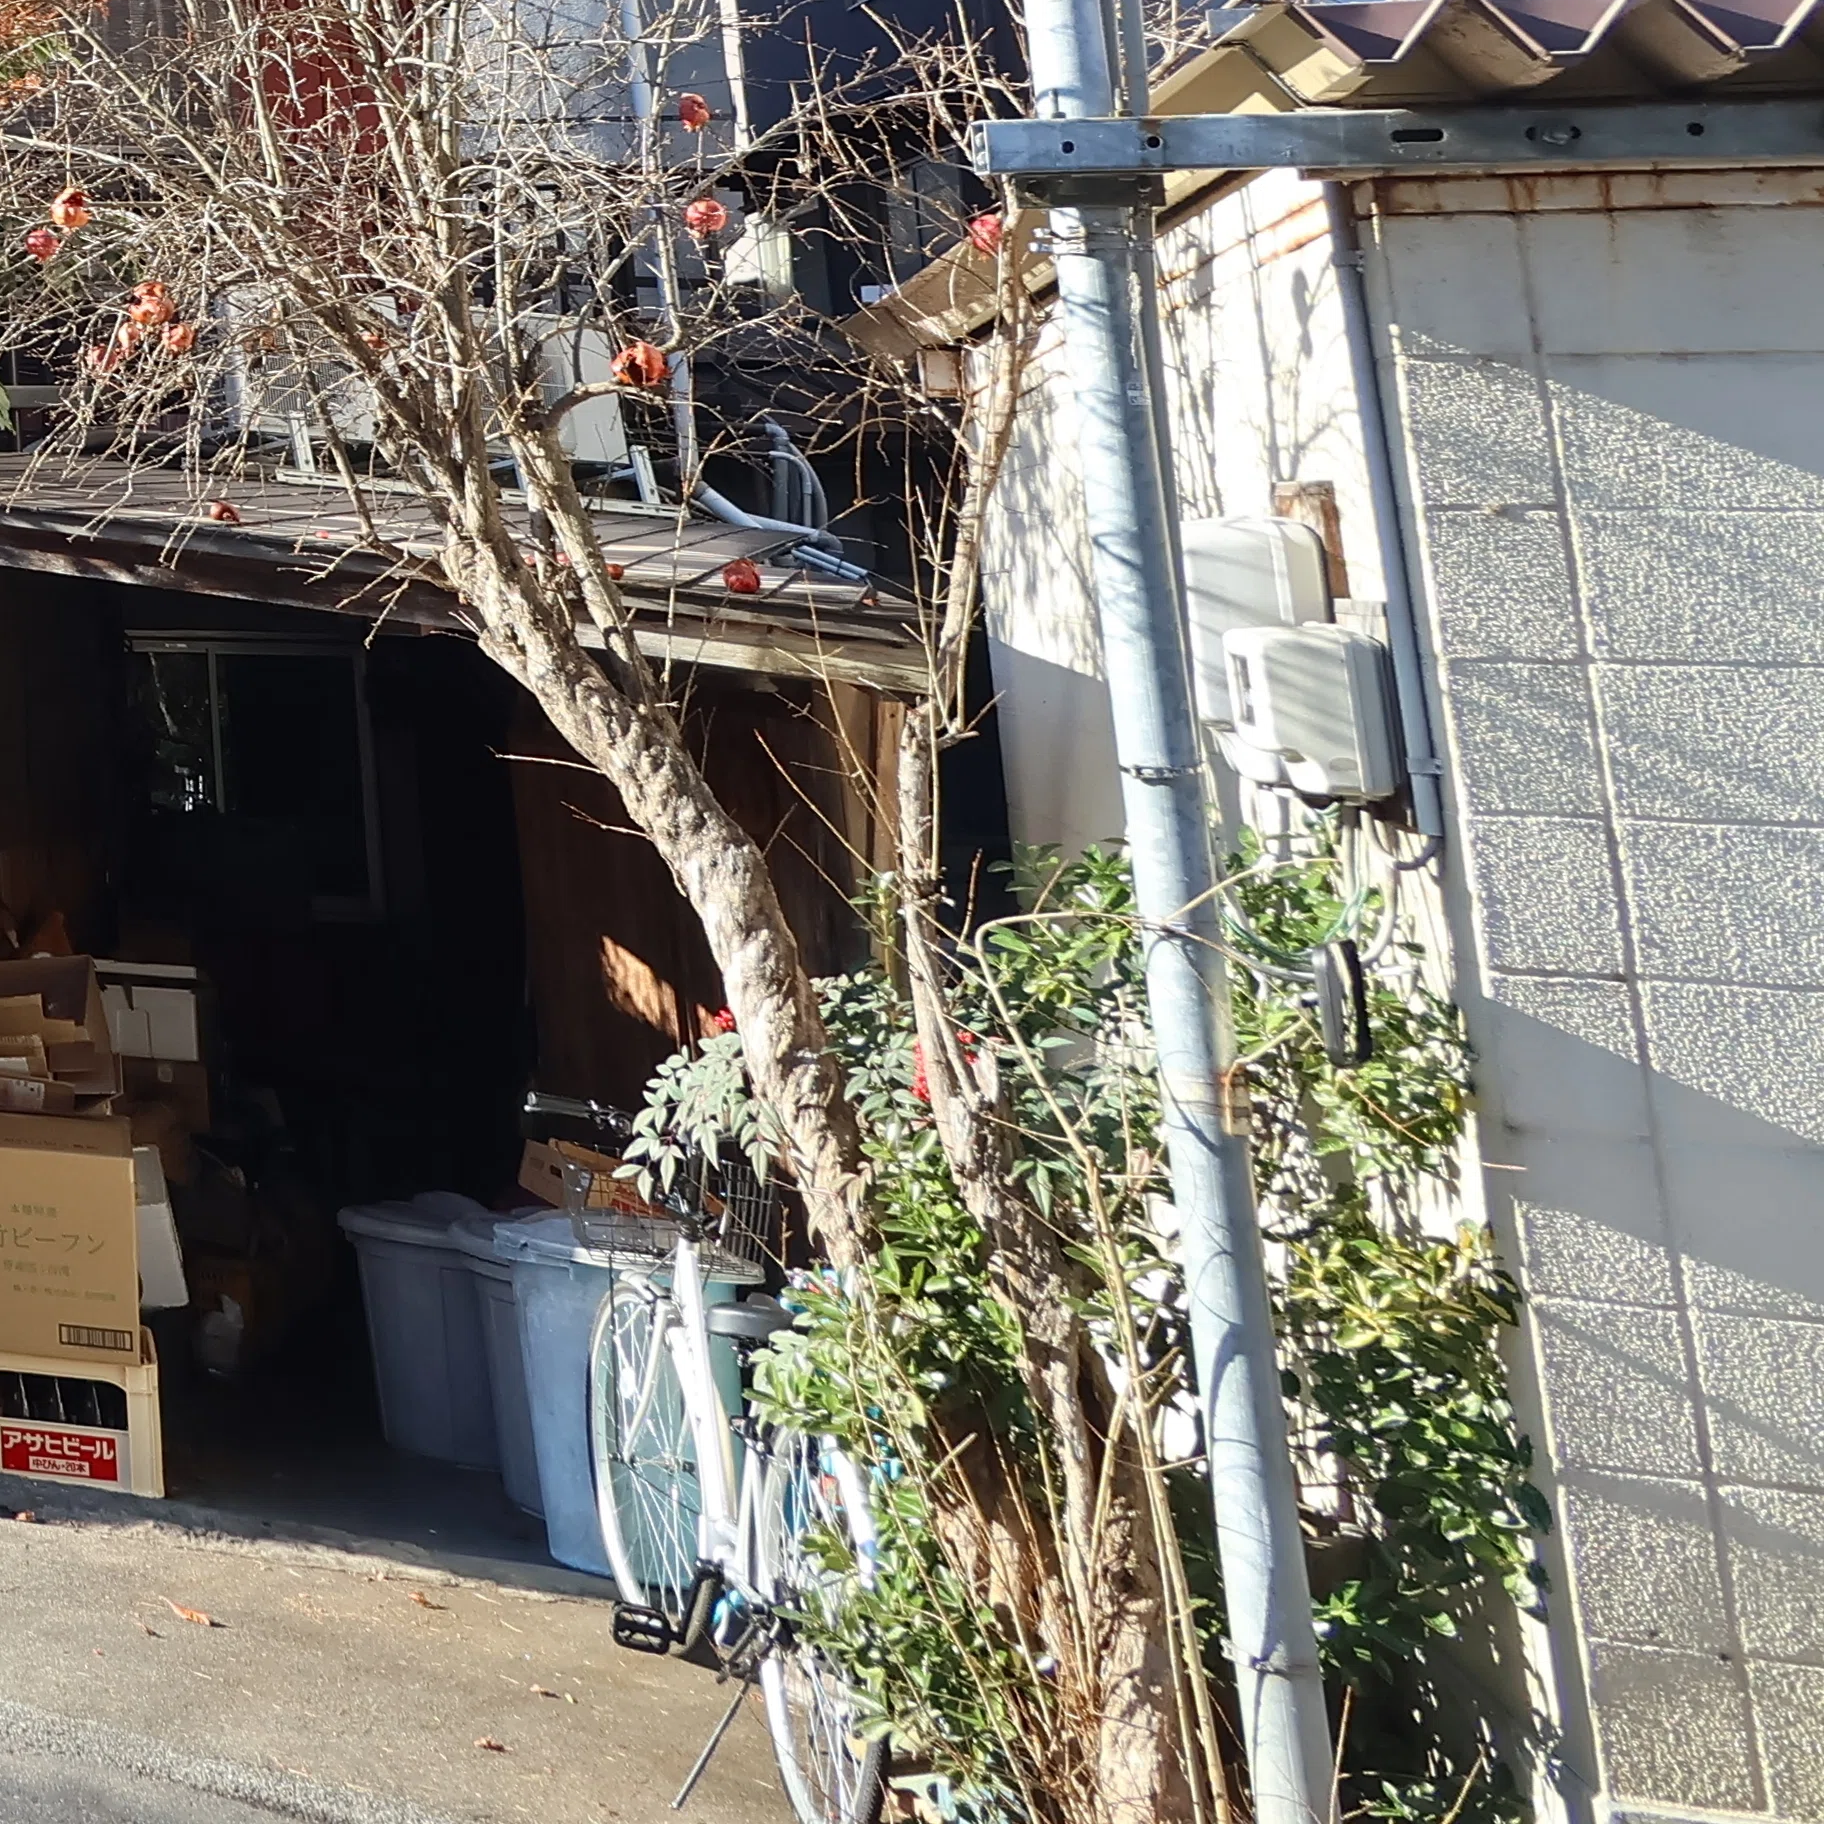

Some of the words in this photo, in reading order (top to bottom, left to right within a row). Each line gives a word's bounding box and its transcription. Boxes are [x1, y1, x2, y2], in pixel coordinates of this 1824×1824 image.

[2, 1429, 115, 1461] アサヒビール
